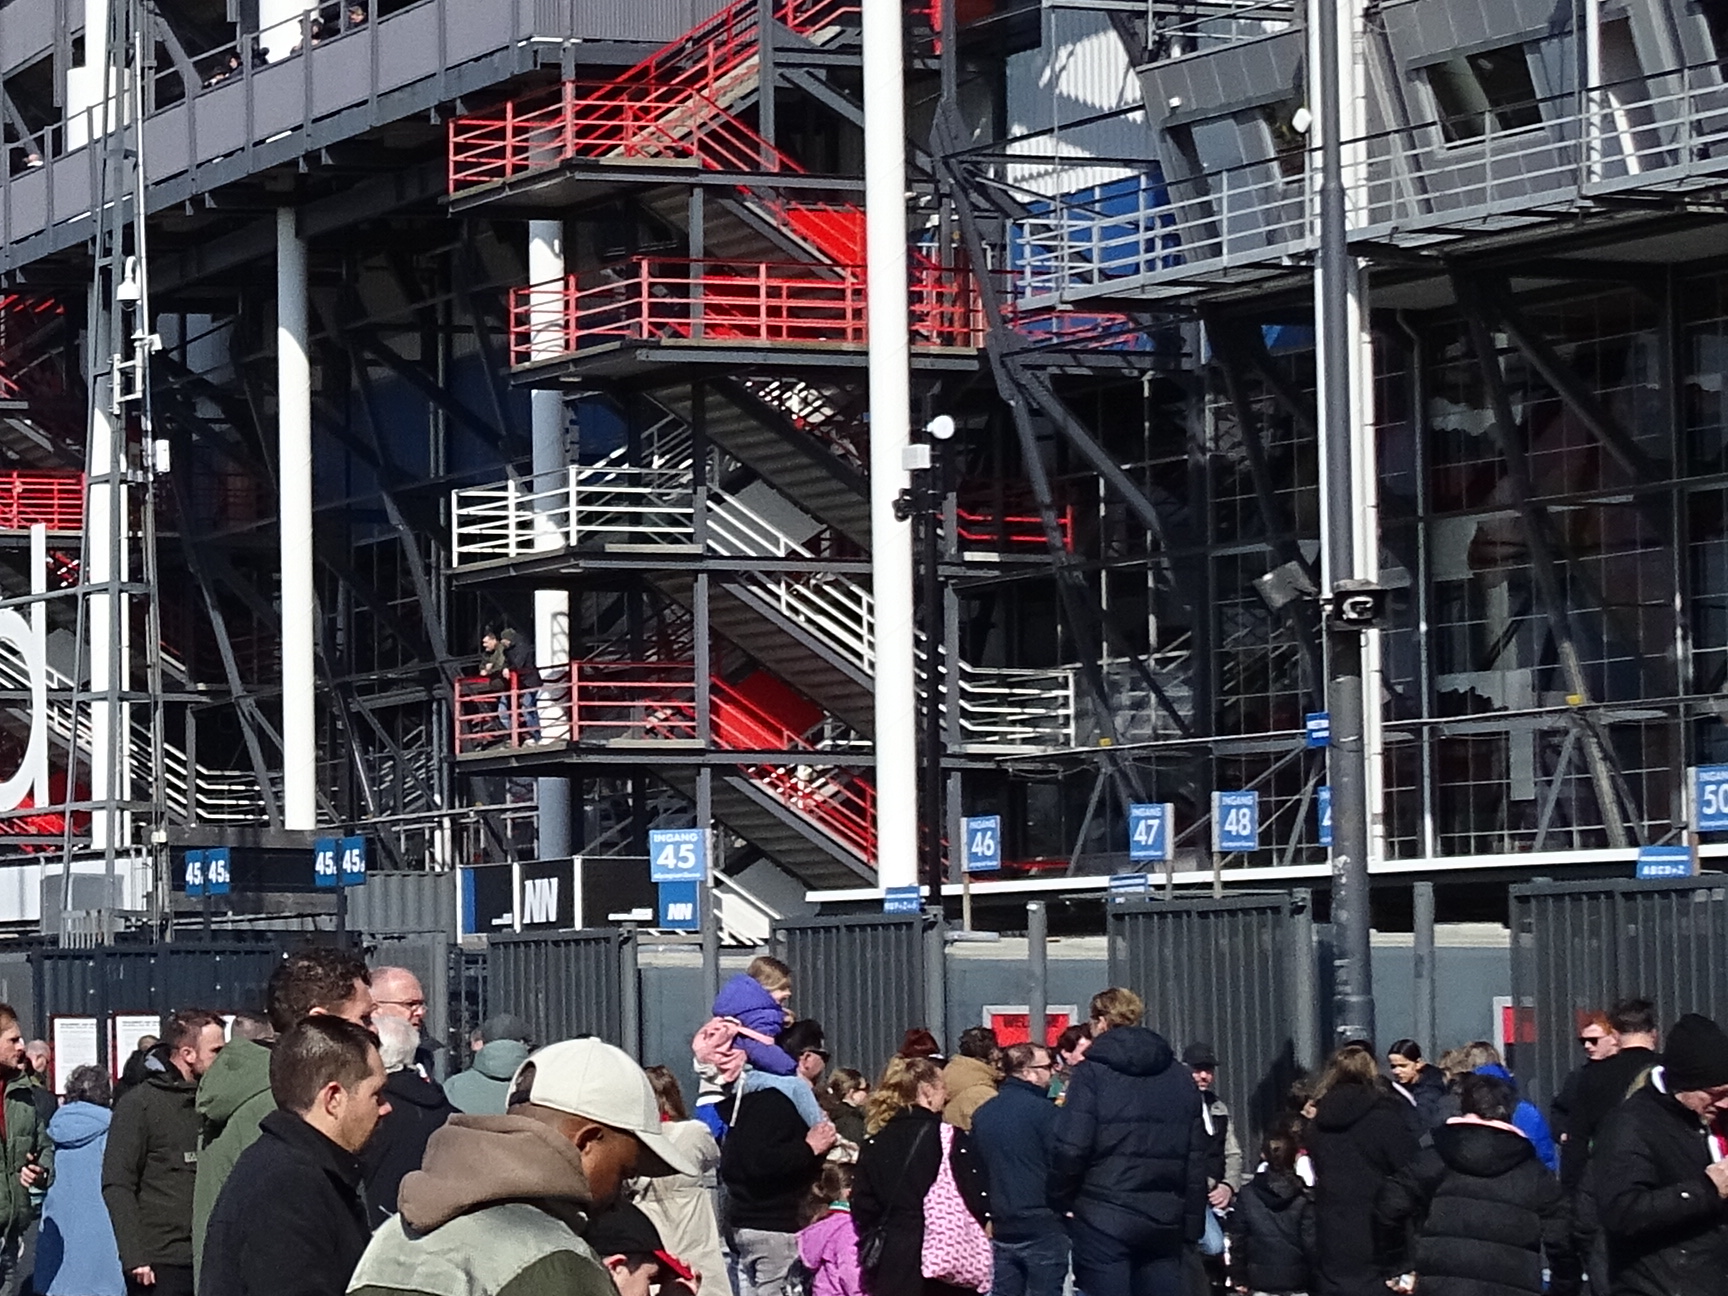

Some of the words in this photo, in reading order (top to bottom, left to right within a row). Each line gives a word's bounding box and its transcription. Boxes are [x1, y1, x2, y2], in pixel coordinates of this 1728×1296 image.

[1702, 783, 1728, 815] 50
[1132, 819, 1161, 845] 47
[1224, 808, 1252, 836] 48
[653, 833, 698, 842] INGANG
[971, 831, 995, 857] 46
[656, 843, 696, 869] 45
[523, 877, 558, 924] NN
[667, 903, 693, 921] NN
